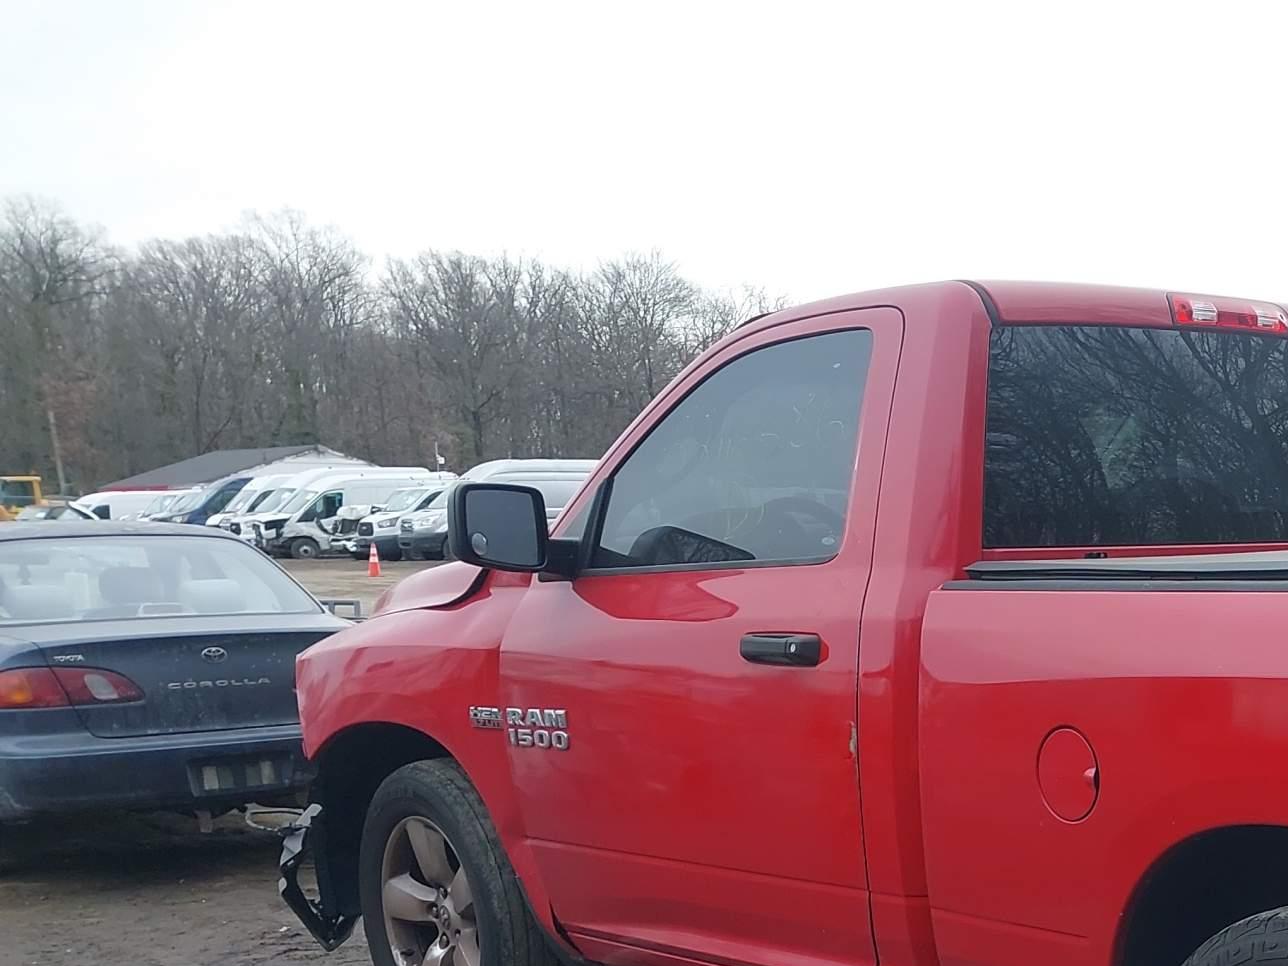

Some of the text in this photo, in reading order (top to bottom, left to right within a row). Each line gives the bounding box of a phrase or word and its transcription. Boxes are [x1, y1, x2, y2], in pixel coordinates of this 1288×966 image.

[167, 677, 271, 690] COROLLA
[506, 707, 568, 729] RAM
[508, 728, 569, 751] 1500
